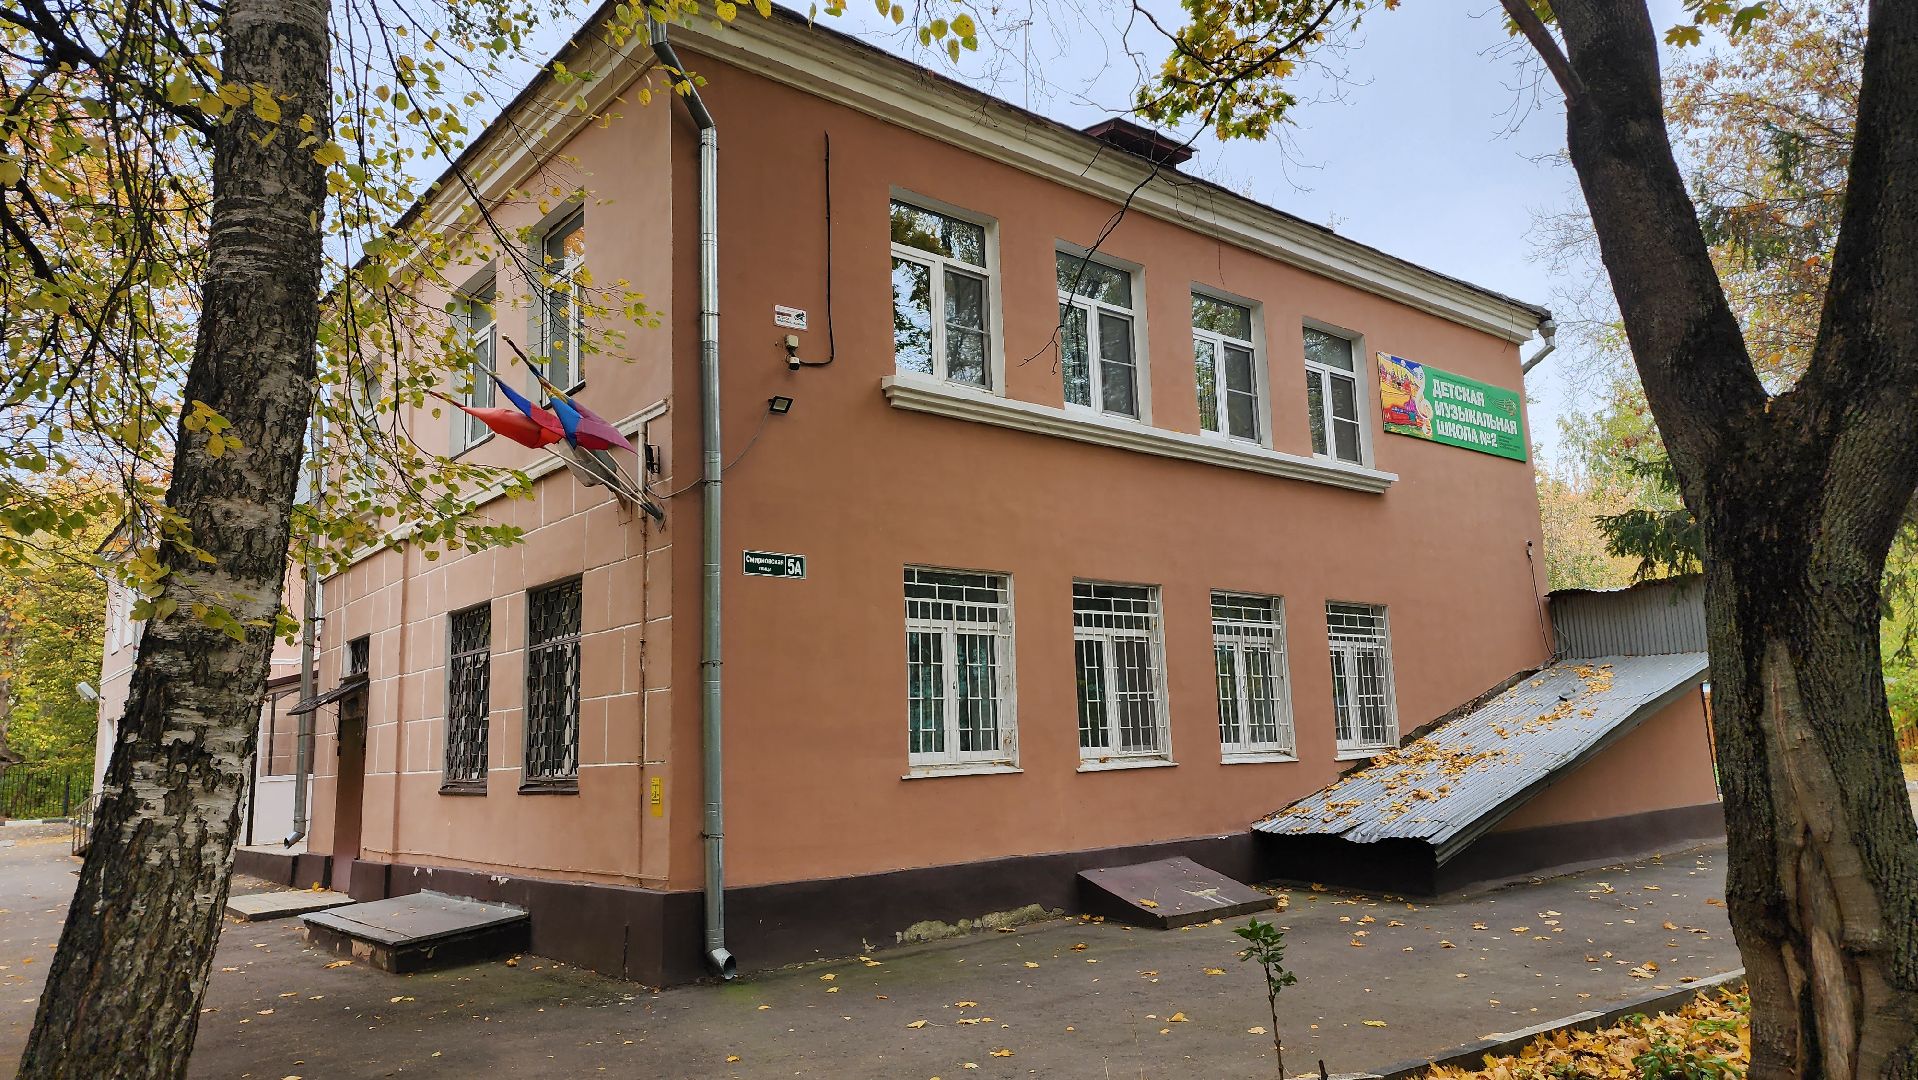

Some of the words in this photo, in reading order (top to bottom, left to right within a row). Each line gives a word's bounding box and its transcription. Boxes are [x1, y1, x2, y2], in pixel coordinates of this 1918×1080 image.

[1432, 378, 1485, 407] ДЕТСКАЯ
[1434, 400, 1518, 435] МУЗЫКАЛЬНАЯ
[1436, 419, 1479, 445] ШКОЛА
[1480, 430, 1498, 447] №2
[787, 558, 802, 575] 5А
